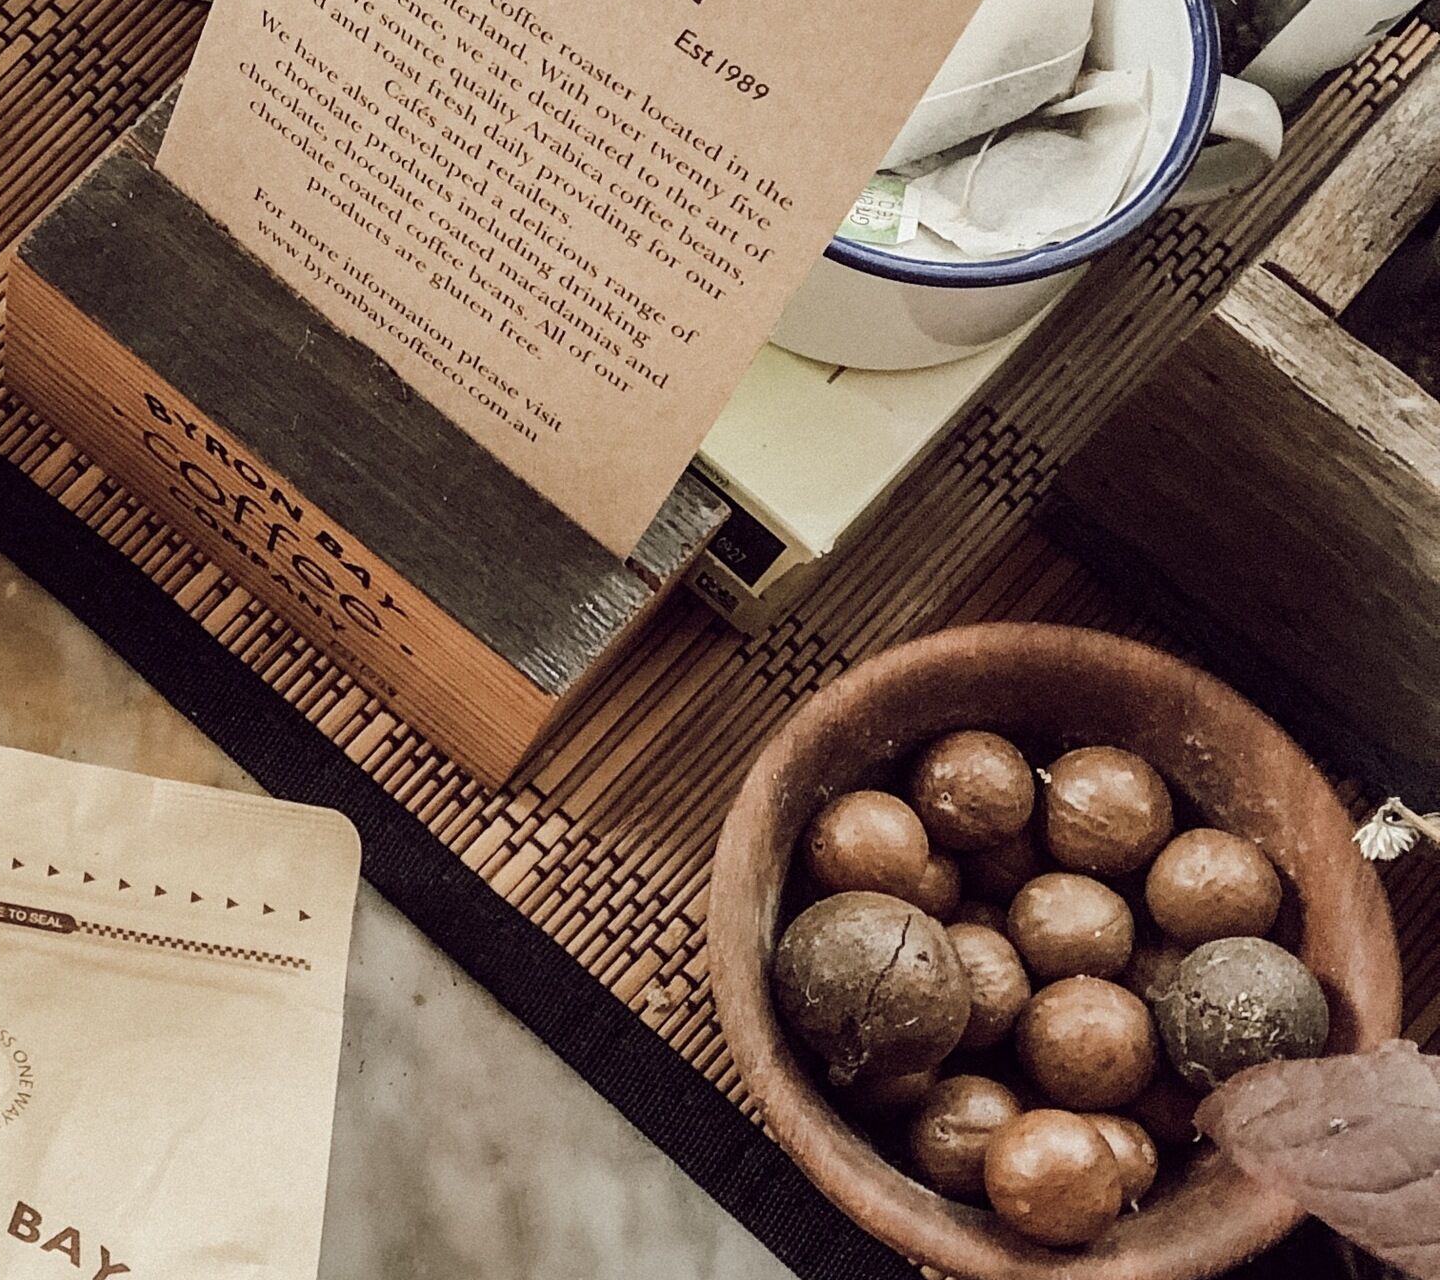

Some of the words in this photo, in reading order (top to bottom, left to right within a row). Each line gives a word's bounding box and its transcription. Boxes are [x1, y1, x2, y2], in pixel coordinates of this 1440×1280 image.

[329, 7, 370, 44] and
[372, 40, 422, 85] roast
[426, 77, 477, 127] fresh
[482, 122, 534, 168] daily
[534, 163, 643, 248] providing
[645, 237, 681, 269] for
[684, 268, 727, 300] our
[377, 12, 445, 68] source
[448, 66, 521, 125] quality
[522, 120, 603, 185] Arabica
[608, 181, 674, 231] coffee
[677, 223, 745, 286] beans,
[383, 78, 437, 128] Cafés
[440, 124, 483, 161] and
[485, 158, 573, 230] retailers.
[455, 35, 484, 64] we
[486, 60, 523, 92] are
[526, 89, 635, 170] dedicated
[636, 165, 660, 188] to
[664, 184, 702, 218] the
[704, 215, 739, 244] art
[743, 242, 775, 264] of
[540, 56, 590, 107] With
[594, 104, 646, 143] over
[649, 140, 725, 201] twenty
[728, 192, 771, 230] five
[557, 42, 637, 101] roaster
[639, 93, 724, 163] located
[725, 153, 749, 183] in
[754, 177, 793, 211] the
[674, 28, 716, 68] Est
[715, 58, 770, 101] 1989
[238, 60, 328, 142] chocolate,
[333, 137, 424, 212] chocolate
[427, 209, 495, 263] coated
[497, 260, 622, 357] macadamias
[623, 354, 669, 390] and
[248, 99, 335, 173] chocolate
[338, 171, 403, 225] coated
[405, 222, 464, 270] coffee
[467, 263, 528, 321] beans.
[533, 318, 567, 346] All
[568, 343, 595, 365] of
[595, 363, 633, 393] our
[261, 8, 290, 43] We
[293, 36, 339, 84] have
[341, 81, 380, 116] also
[383, 113, 489, 197] developed
[489, 194, 504, 210] a
[508, 206, 598, 278] delicious
[603, 275, 666, 325] range
[669, 323, 700, 344] of
[274, 58, 363, 134] chocolate
[363, 131, 453, 203] products
[456, 195, 555, 280] including
[557, 273, 651, 349] drinking
[305, 175, 391, 246] products
[393, 244, 427, 271] are
[427, 271, 493, 323] gluten
[498, 317, 541, 360] free.
[252, 185, 286, 220] For
[288, 218, 339, 262] more
[341, 255, 454, 351] information
[455, 348, 519, 398] please
[525, 396, 562, 433] visit
[257, 219, 538, 443] www.byronbaycoffeeco.com.au
[143, 392, 304, 523] BYRON
[315, 530, 408, 618] BAY
[143, 431, 383, 638] coffee
[169, 486, 345, 632] COMPANY
[8, 908, 28, 923] TO
[29, 912, 64, 929] SEAL
[1, 1091, 33, 1127] WAY
[12, 1049, 35, 1090] ONE
